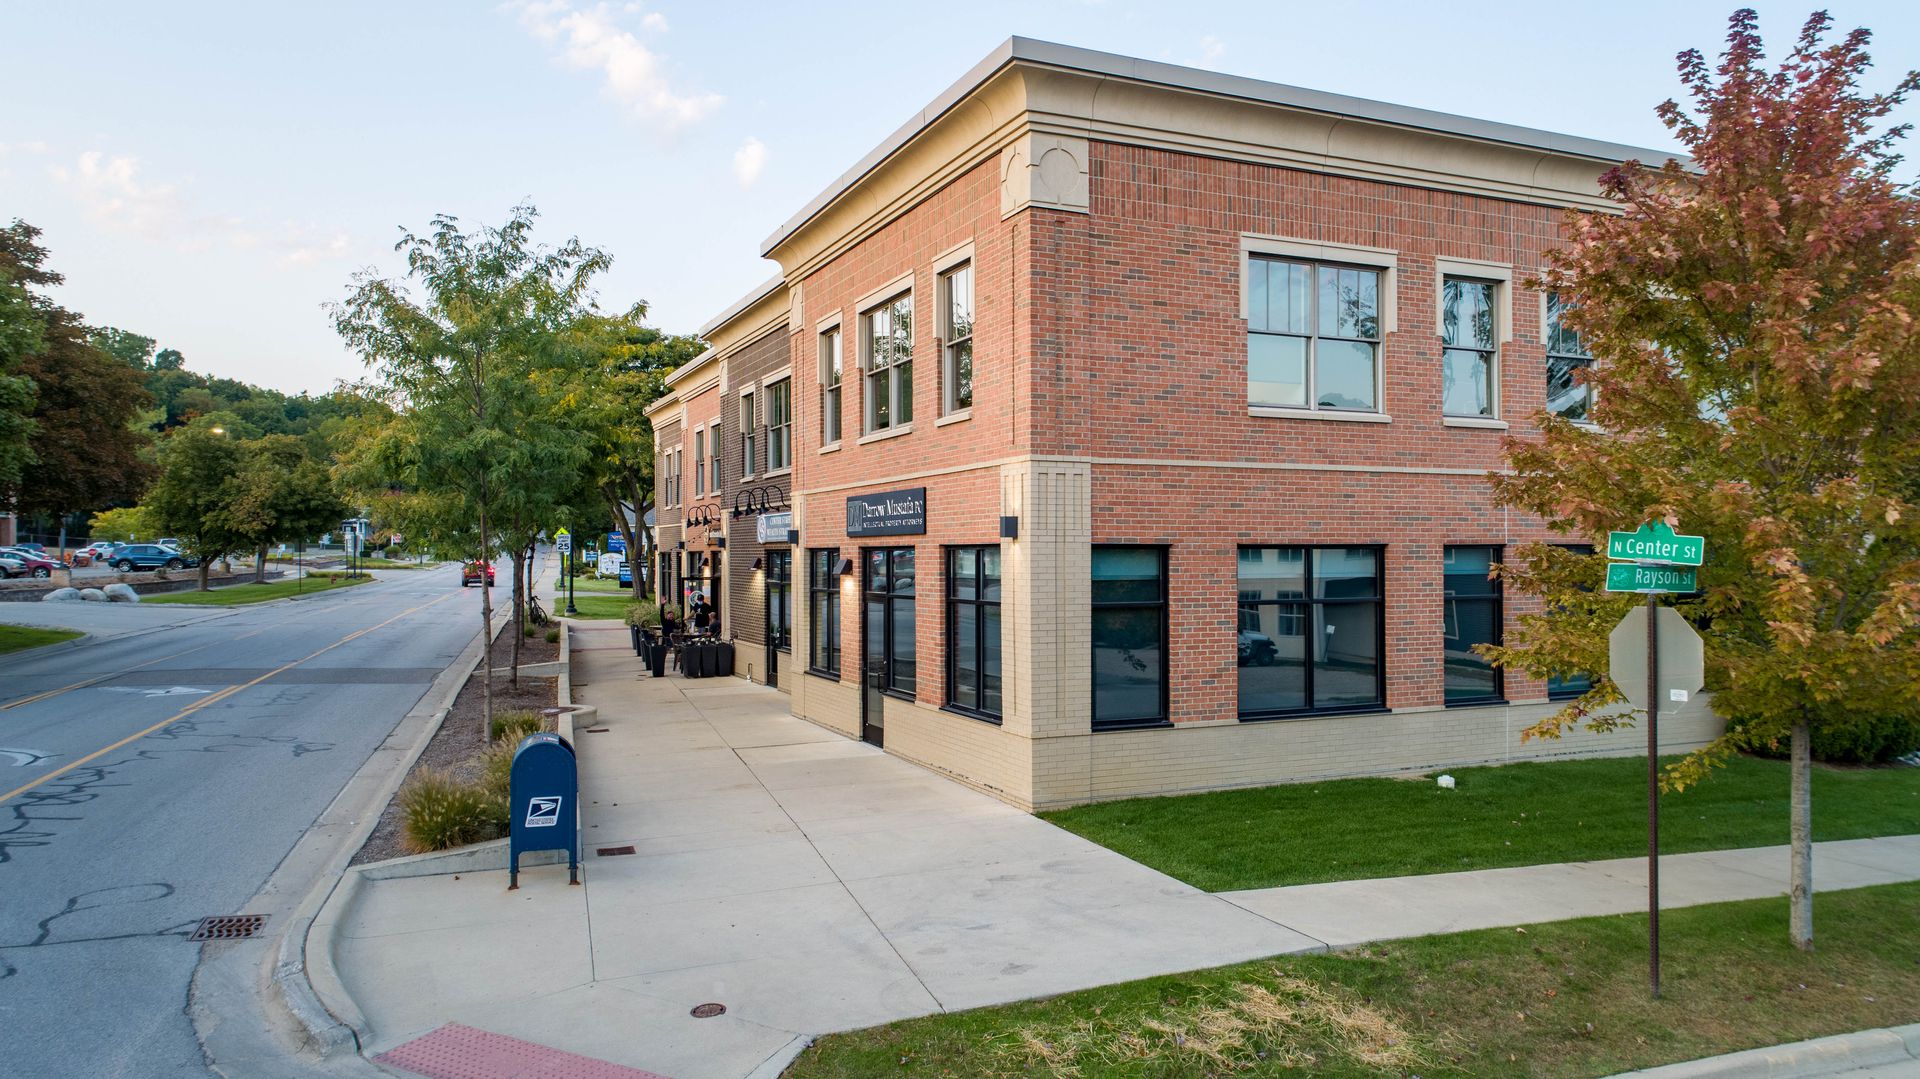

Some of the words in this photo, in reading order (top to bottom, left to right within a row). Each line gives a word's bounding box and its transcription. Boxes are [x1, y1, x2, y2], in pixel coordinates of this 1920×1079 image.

[862, 502, 885, 518] Darrow
[886, 497, 913, 516] Mustafa
[558, 542, 570, 550] 25
[1614, 541, 1622, 553] N
[1626, 538, 1679, 557] Center
[1684, 545, 1696, 558] St
[1635, 568, 1679, 588] Rayson
[1682, 573, 1691, 585] St
